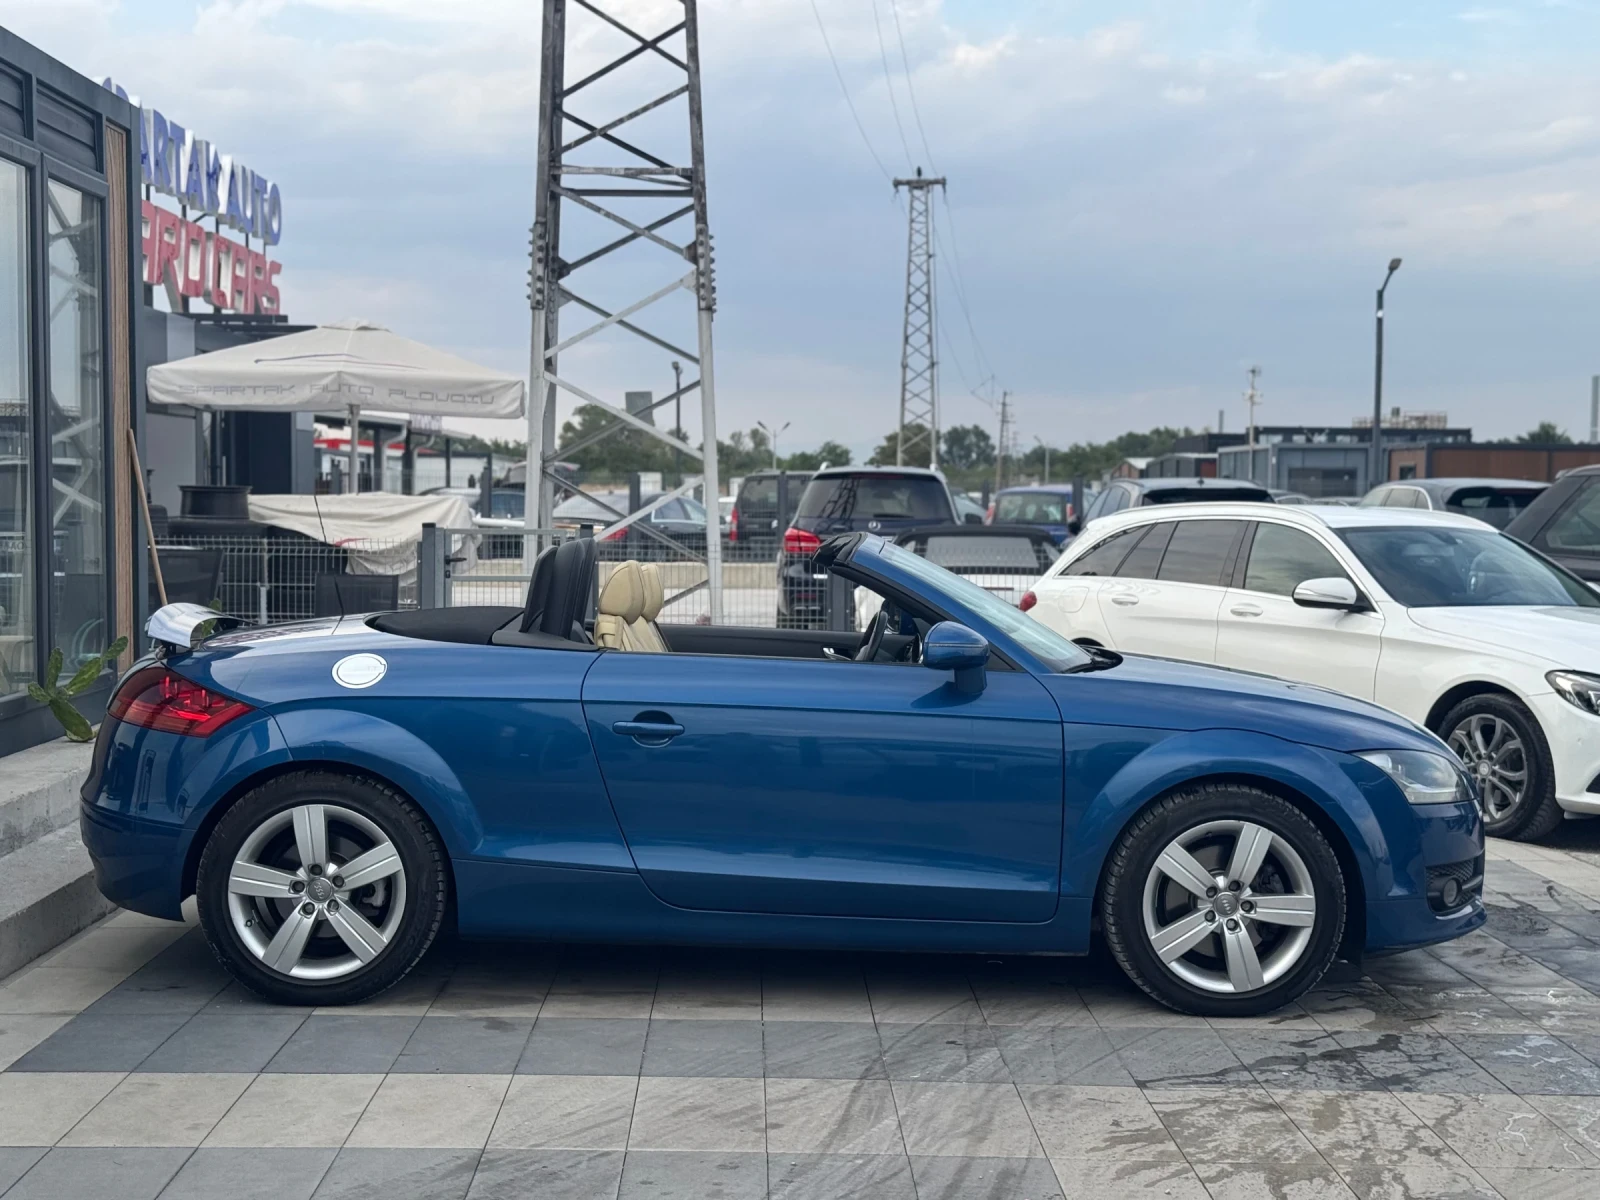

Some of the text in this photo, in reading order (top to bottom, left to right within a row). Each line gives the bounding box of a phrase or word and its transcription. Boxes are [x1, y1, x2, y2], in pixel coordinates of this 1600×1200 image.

[222, 157, 282, 246] AUTO
[177, 383, 296, 396] SPARTAK
[309, 383, 375, 396] AUTO
